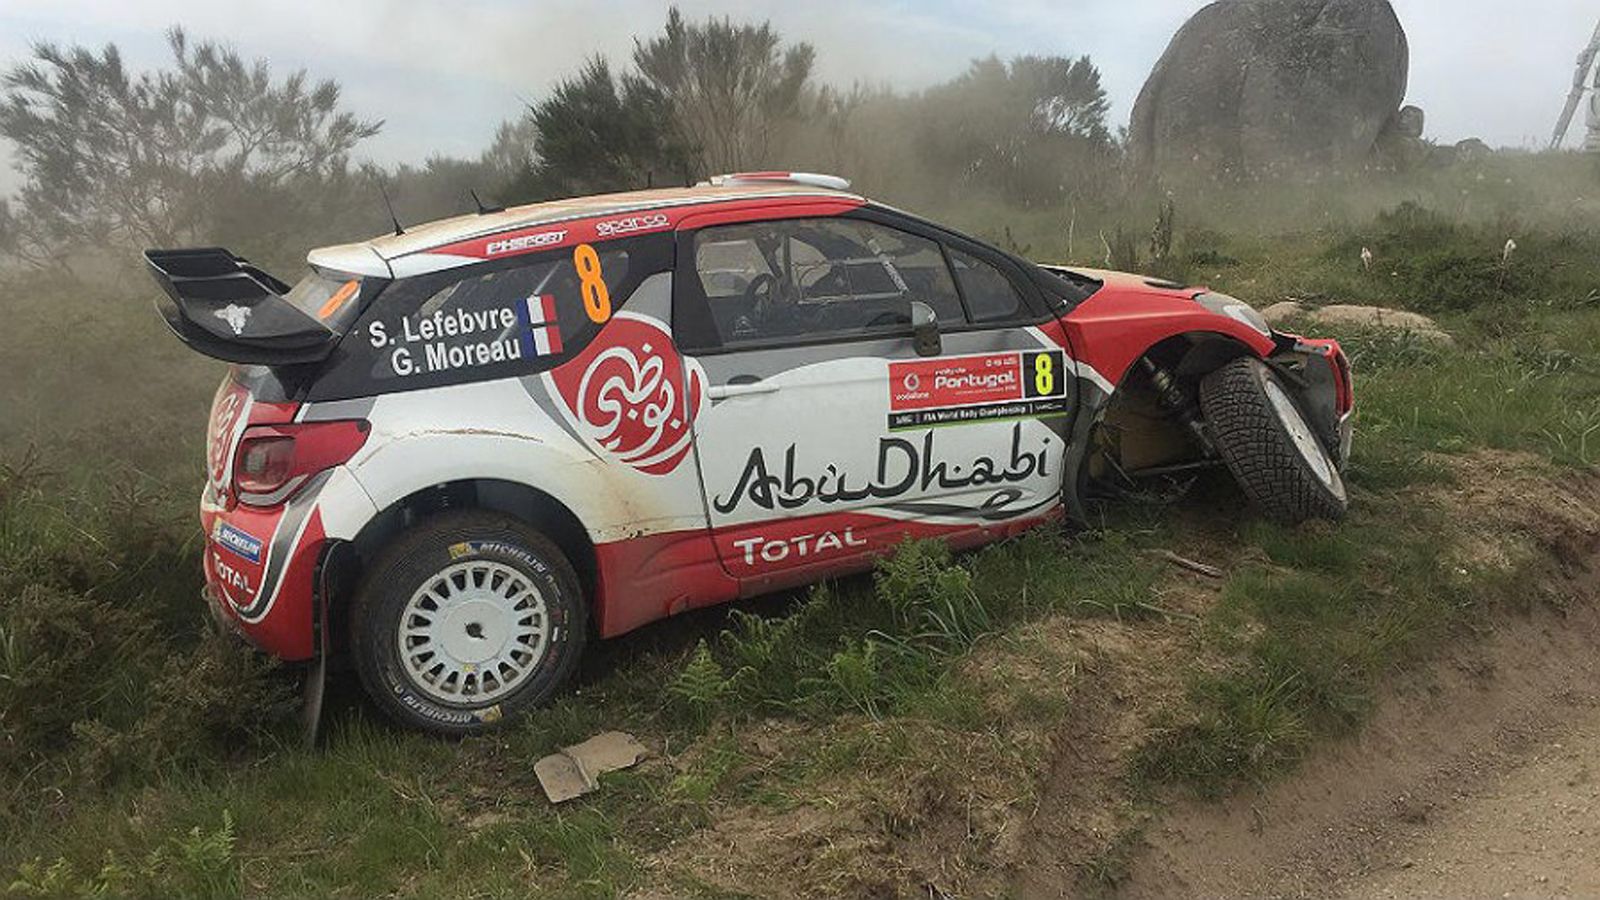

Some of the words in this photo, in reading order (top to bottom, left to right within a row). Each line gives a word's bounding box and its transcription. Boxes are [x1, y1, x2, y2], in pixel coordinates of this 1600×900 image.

[594, 214, 670, 237] sparco
[574, 243, 612, 325] 8
[369, 320, 396, 348] S.
[402, 307, 515, 343] Lefebvre
[391, 348, 421, 376] G.
[424, 337, 522, 372] Moreau
[1035, 352, 1054, 396] 8
[934, 370, 1015, 390] Portugal
[877, 421, 1052, 496] Dhabi
[479, 542, 547, 574] MICHELIN
[733, 526, 868, 566] TOTAL
[212, 551, 255, 595] TOTAL
